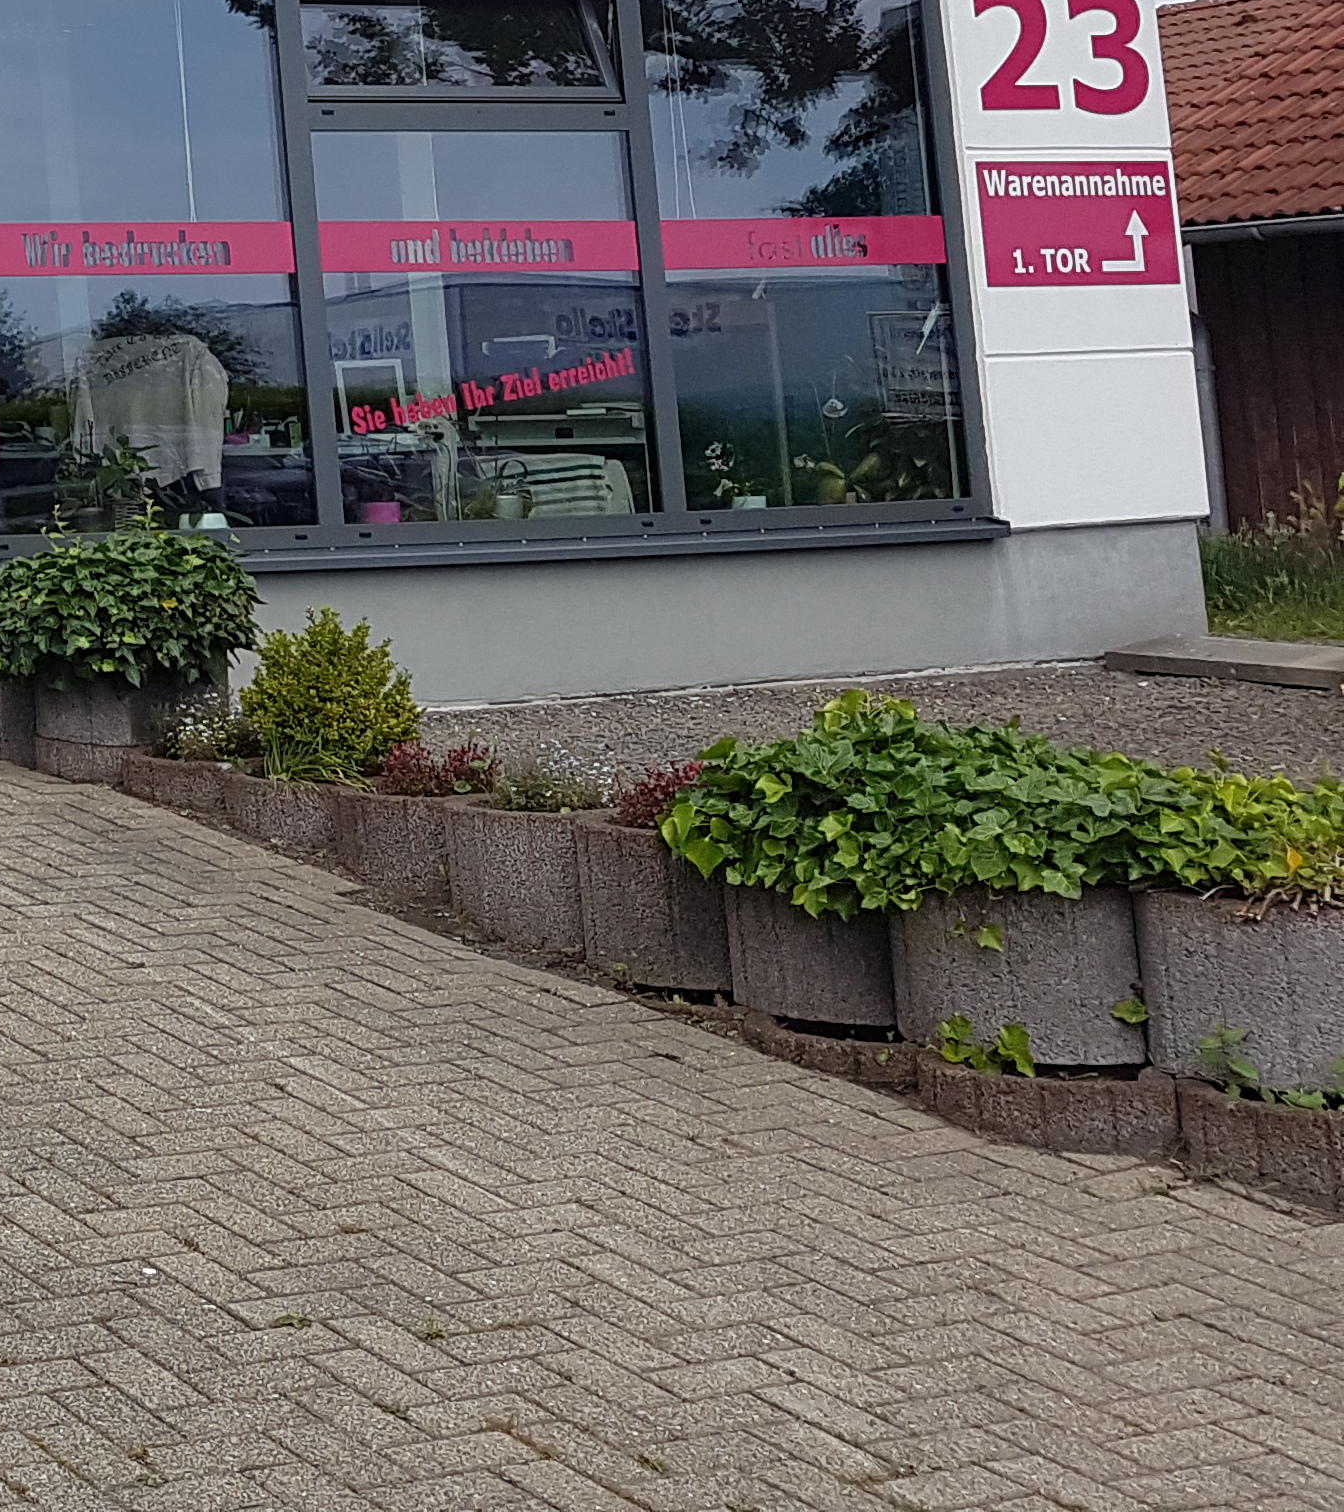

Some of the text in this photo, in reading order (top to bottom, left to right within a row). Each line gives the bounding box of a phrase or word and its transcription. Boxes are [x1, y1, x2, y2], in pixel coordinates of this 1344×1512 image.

[982, 169, 1166, 198] Warenannahme
[20, 229, 232, 268] Wir bedrucken
[390, 228, 574, 264] und bekleben
[1012, 248, 1092, 273] 1. TOR
[351, 347, 635, 435] Sie haben Ihr Ziel erreicht!
